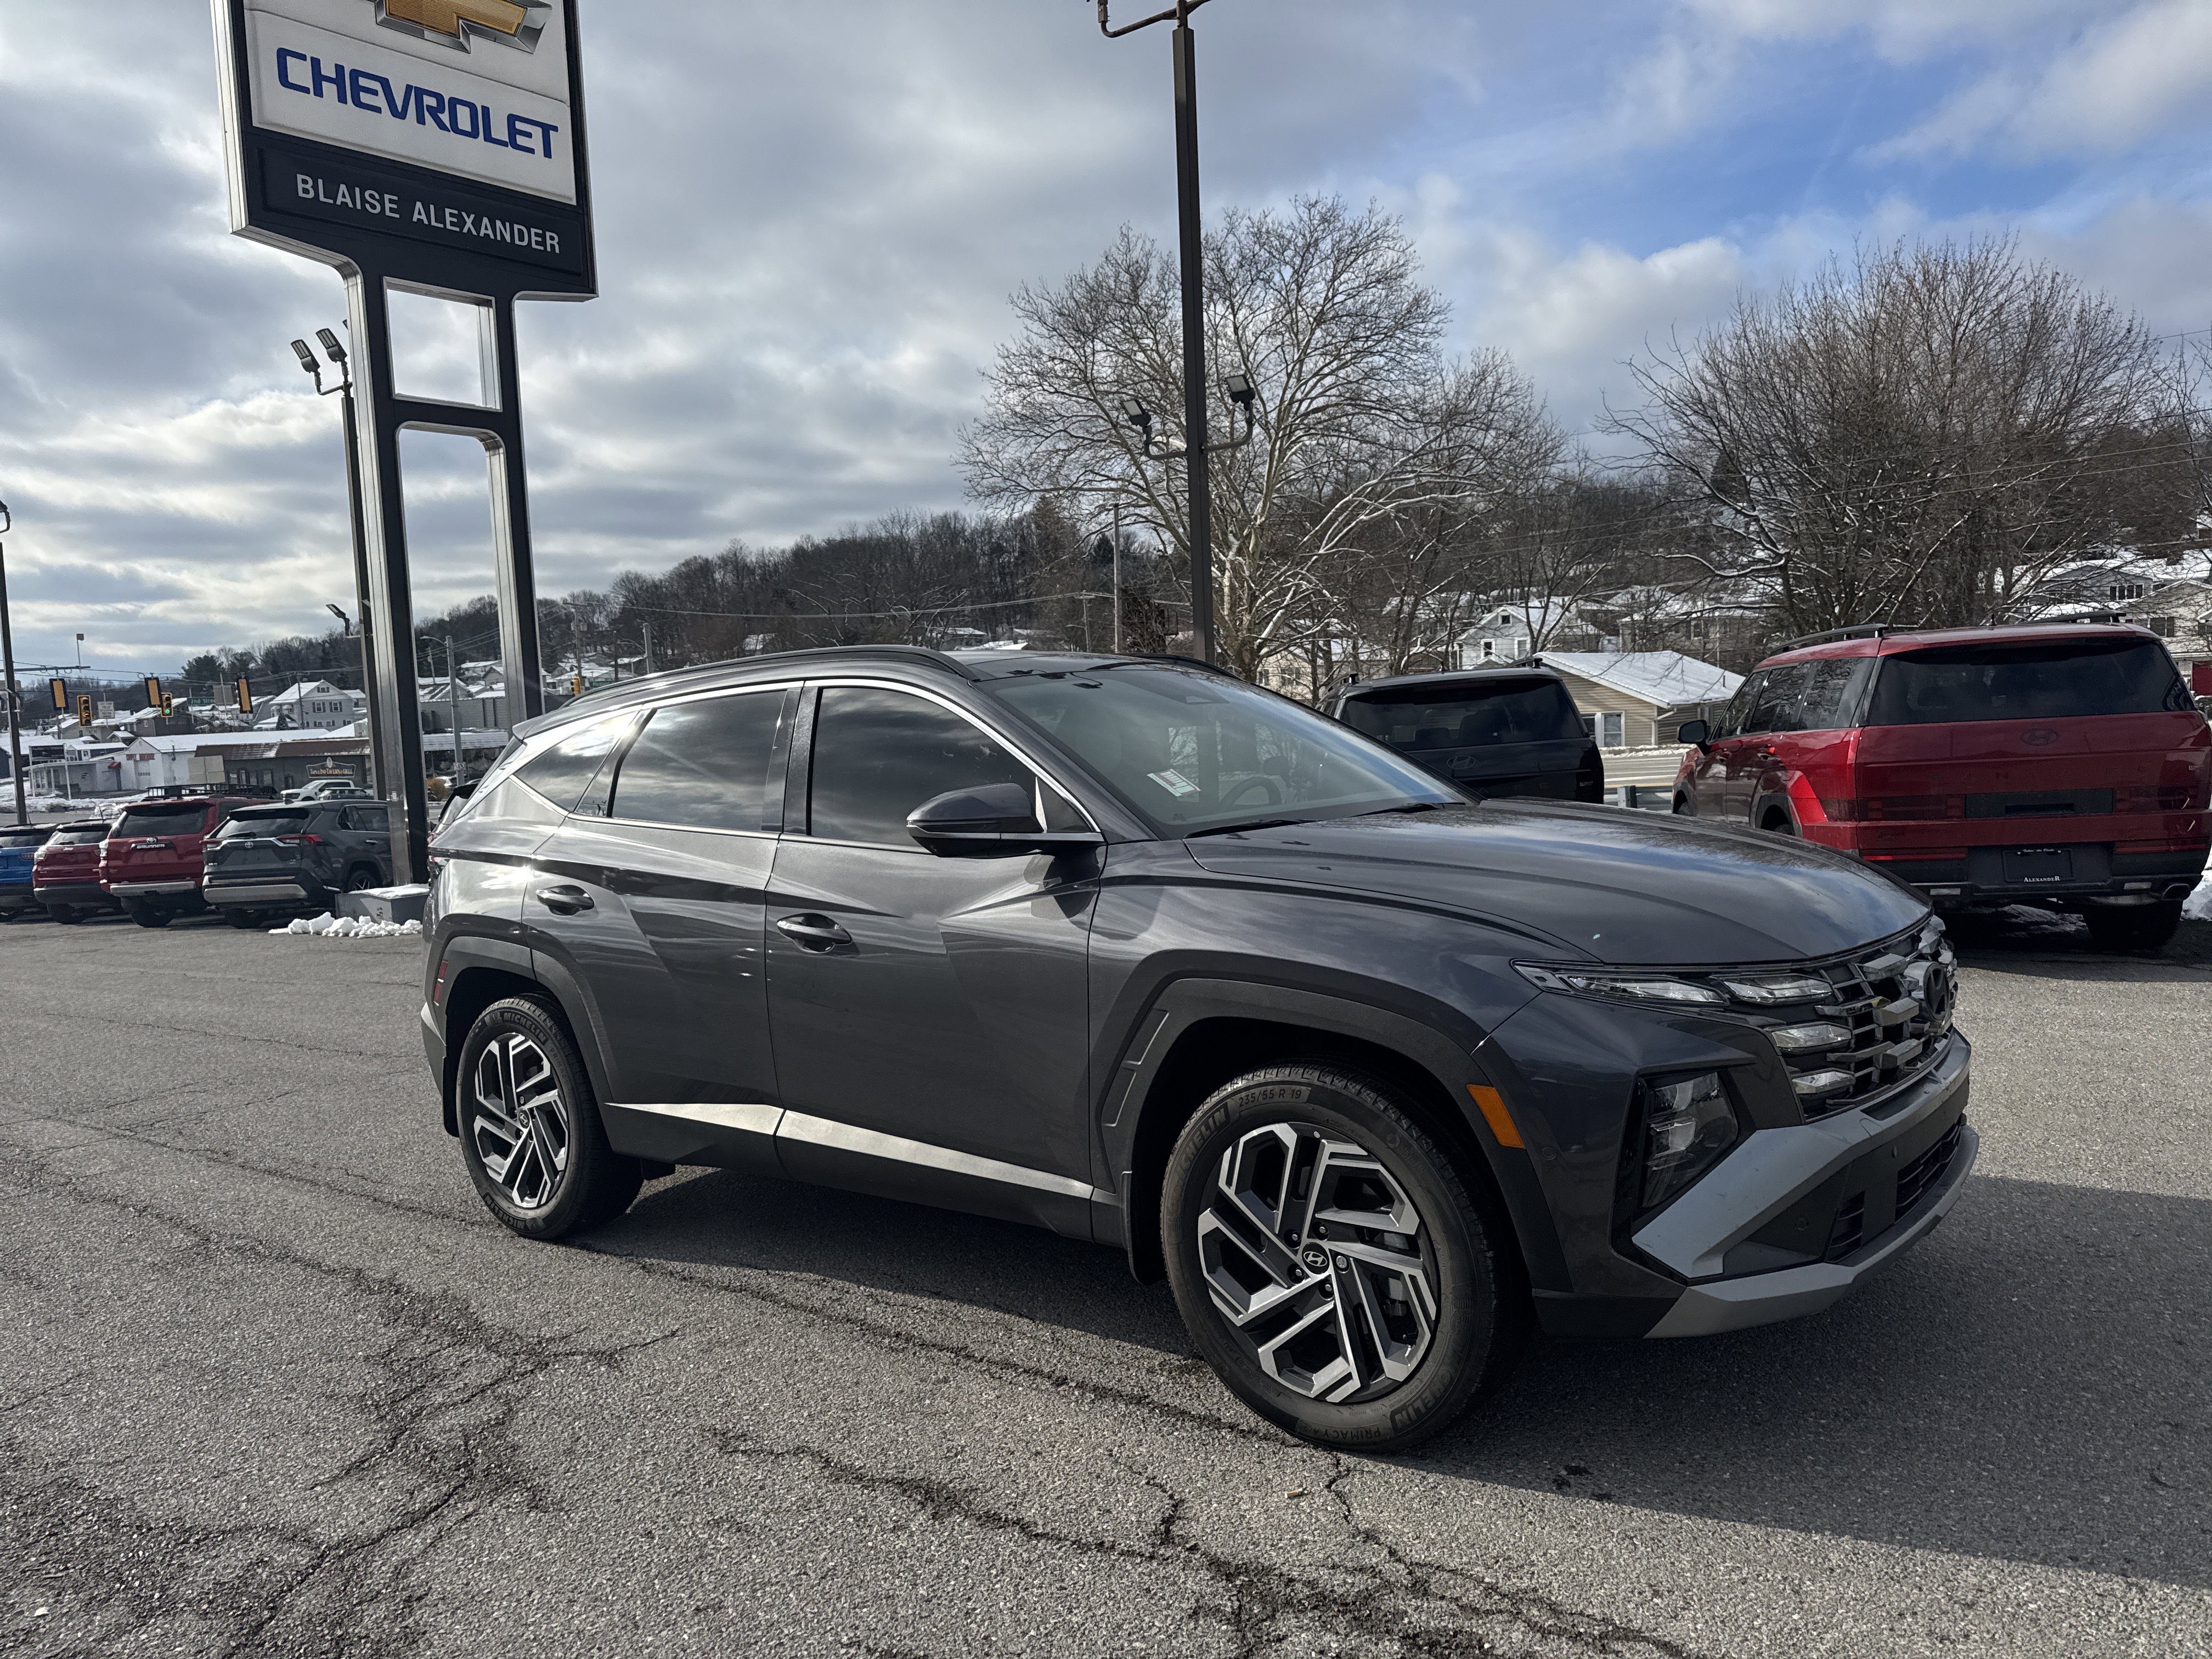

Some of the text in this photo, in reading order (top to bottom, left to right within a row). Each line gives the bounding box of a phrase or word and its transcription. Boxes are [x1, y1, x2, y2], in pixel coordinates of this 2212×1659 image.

[276, 47, 558, 159] CHEVROLET
[296, 174, 561, 254] BLAISE ALEXANDER
[503, 1012, 546, 1043] MICHELIN
[1173, 1089, 1302, 1193] MICHELIN 235/55 R 19
[485, 1195, 525, 1229] MICHELIN
[1323, 1427, 1381, 1441] PRIMACY
